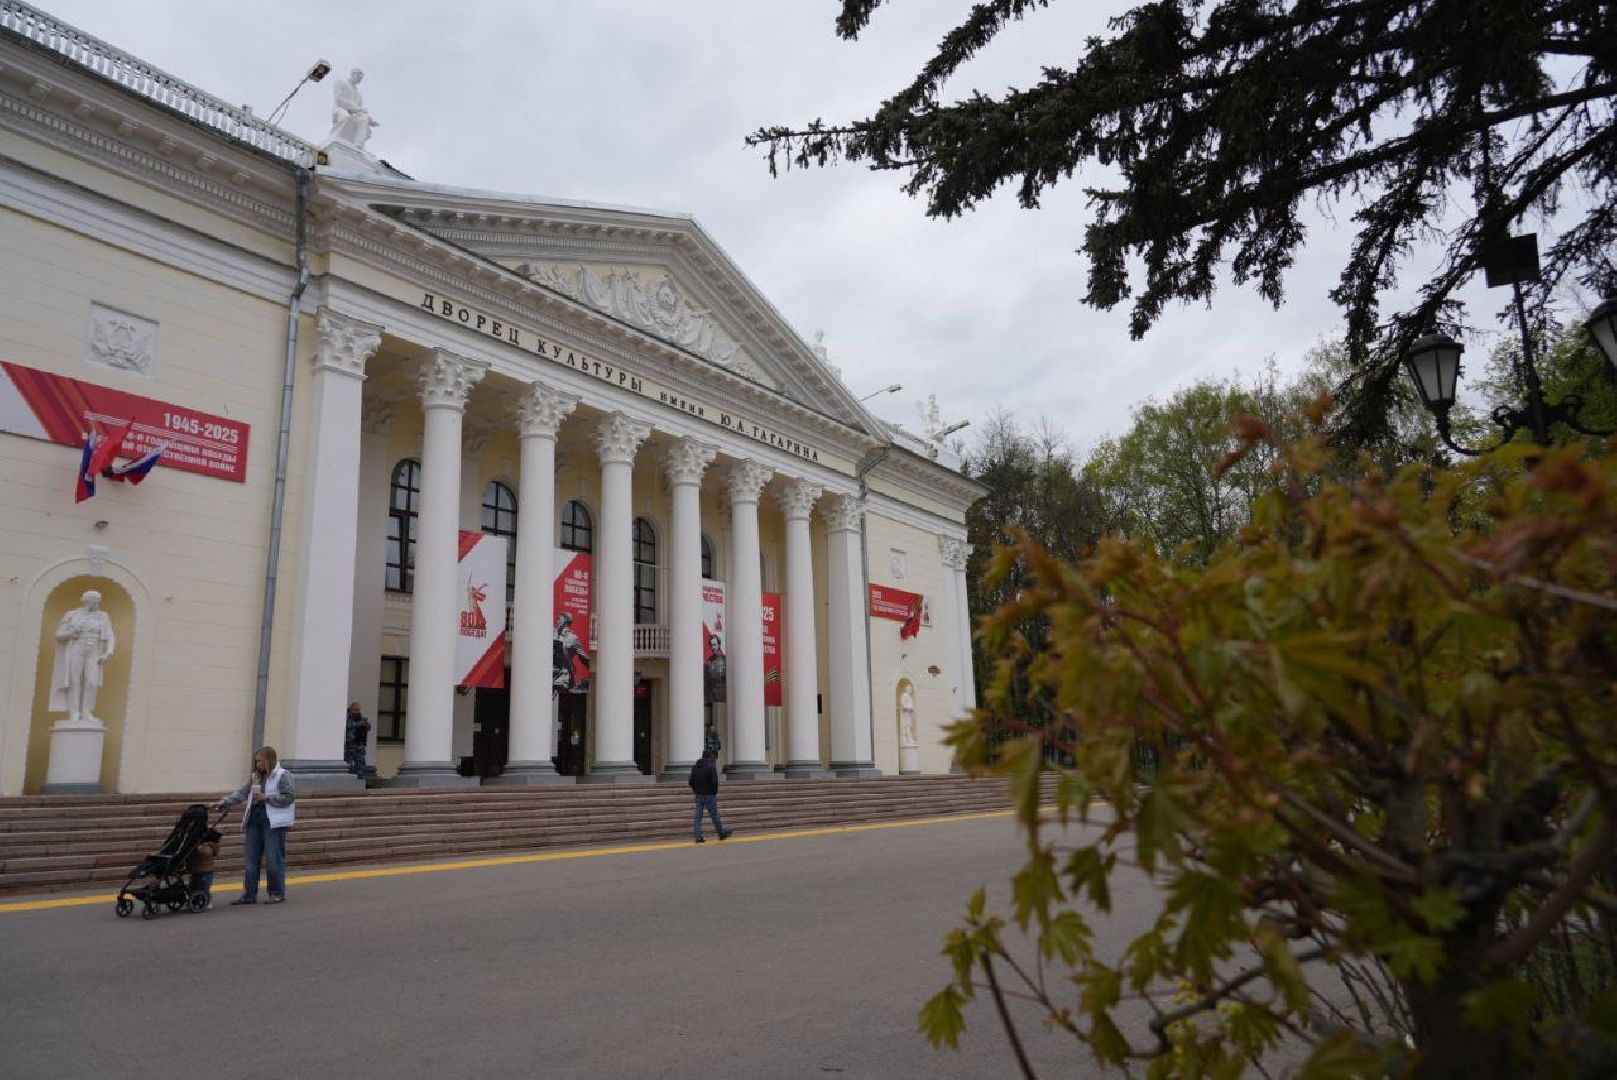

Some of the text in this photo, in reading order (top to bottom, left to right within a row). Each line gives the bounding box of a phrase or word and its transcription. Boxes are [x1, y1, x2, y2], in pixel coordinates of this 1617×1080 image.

[420, 293, 519, 345] ДВОРЕЦ
[537, 340, 642, 392] КУЛЬТУРЫ
[164, 413, 238, 443] 1945-2025
